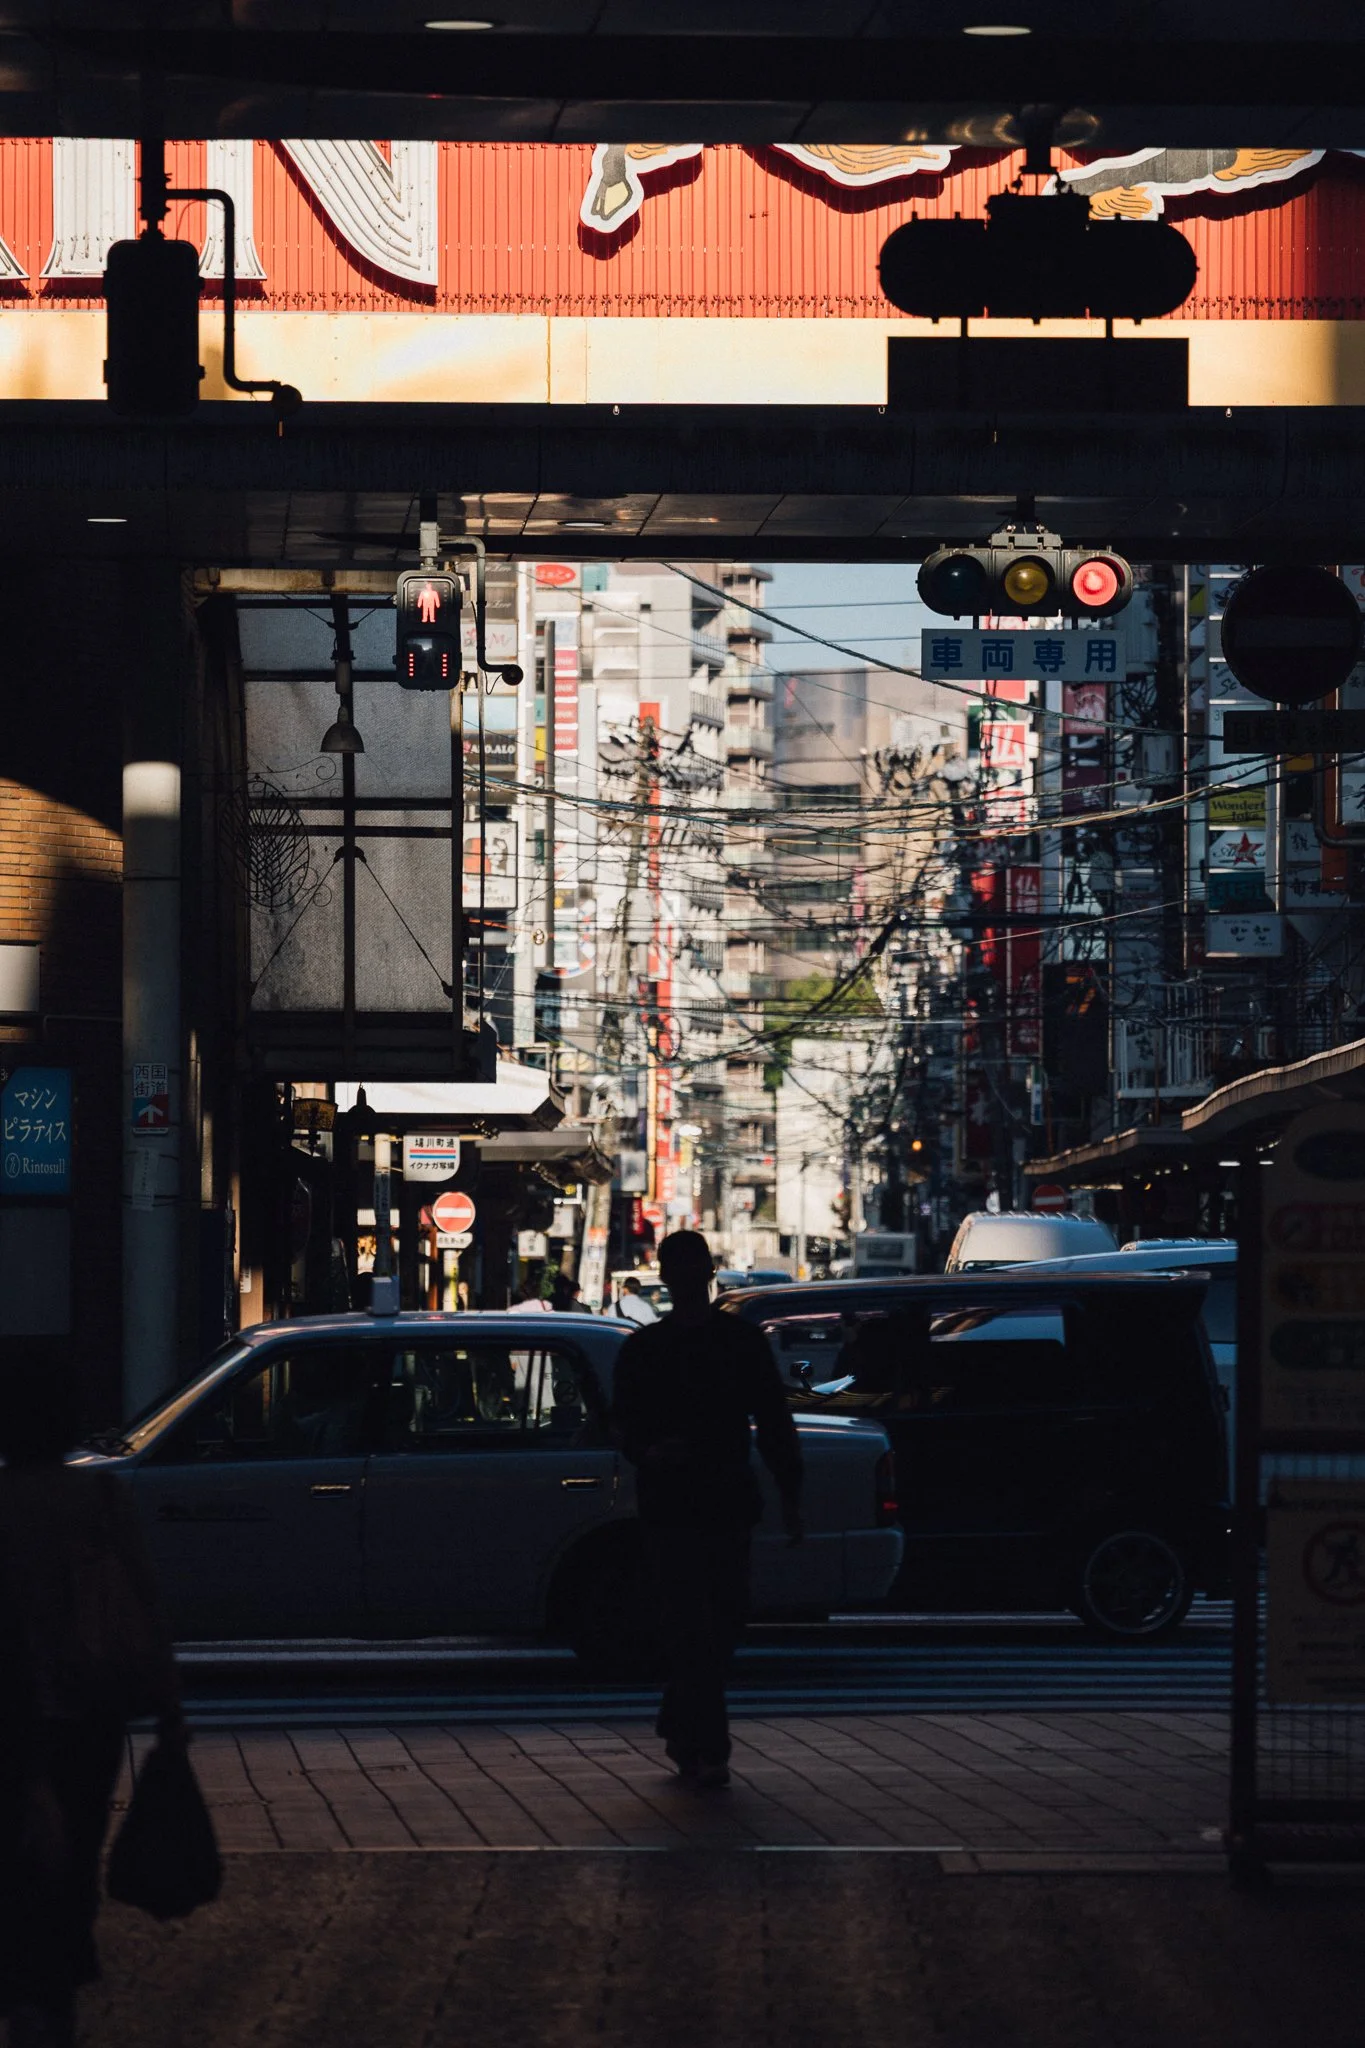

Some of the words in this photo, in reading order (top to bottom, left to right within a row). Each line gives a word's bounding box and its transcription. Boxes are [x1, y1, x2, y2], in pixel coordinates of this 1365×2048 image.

[930, 637, 1117, 673] 車両専用
[135, 1064, 166, 1080] 西国
[14, 1087, 57, 1110] マシン
[134, 1080, 168, 1098] 街道
[4, 1116, 67, 1145] ピラティス
[23, 1157, 65, 1174] Rintosull
